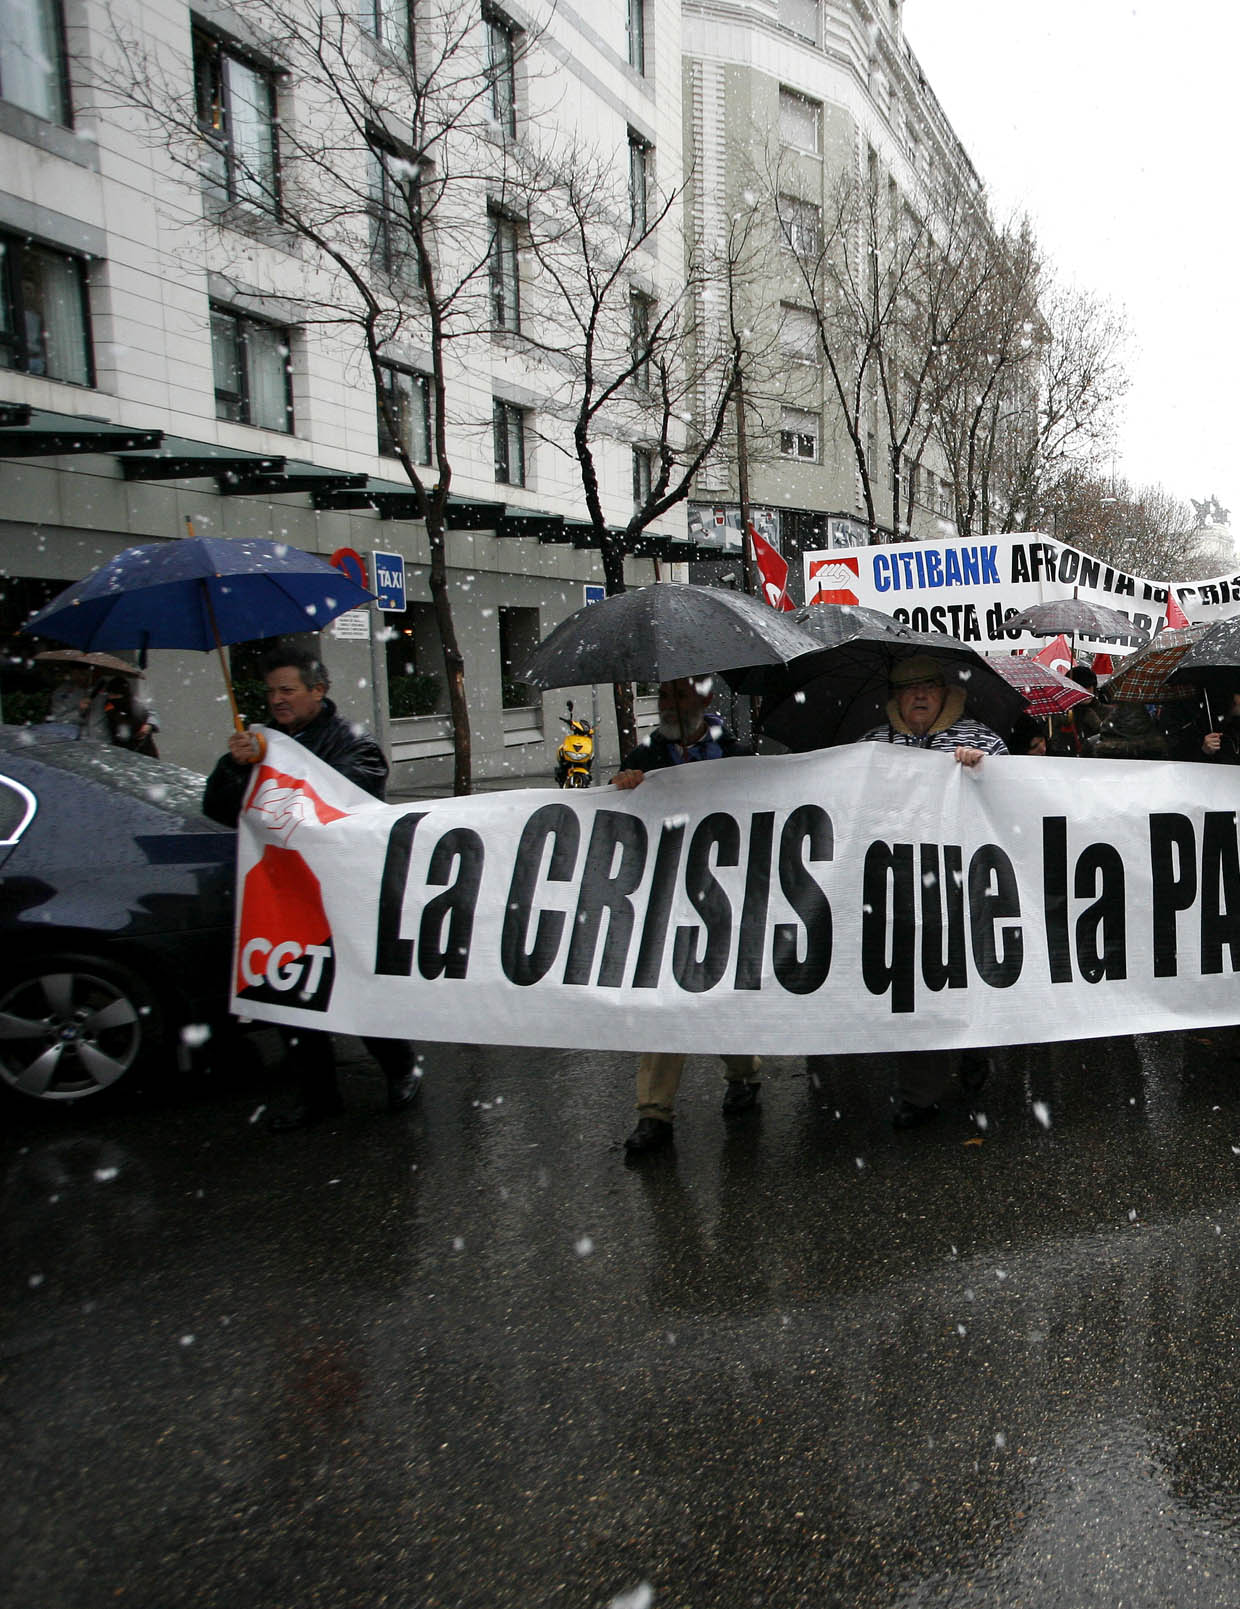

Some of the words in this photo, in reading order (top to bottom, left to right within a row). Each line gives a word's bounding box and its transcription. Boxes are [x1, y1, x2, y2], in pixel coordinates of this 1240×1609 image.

[378, 570, 403, 589] TAXI
[873, 546, 1000, 592] CITIBANK
[374, 811, 485, 981] La
[501, 803, 834, 995] CRISIS
[862, 839, 1024, 1013] que
[1042, 816, 1127, 984] la
[241, 937, 332, 994] CGT
